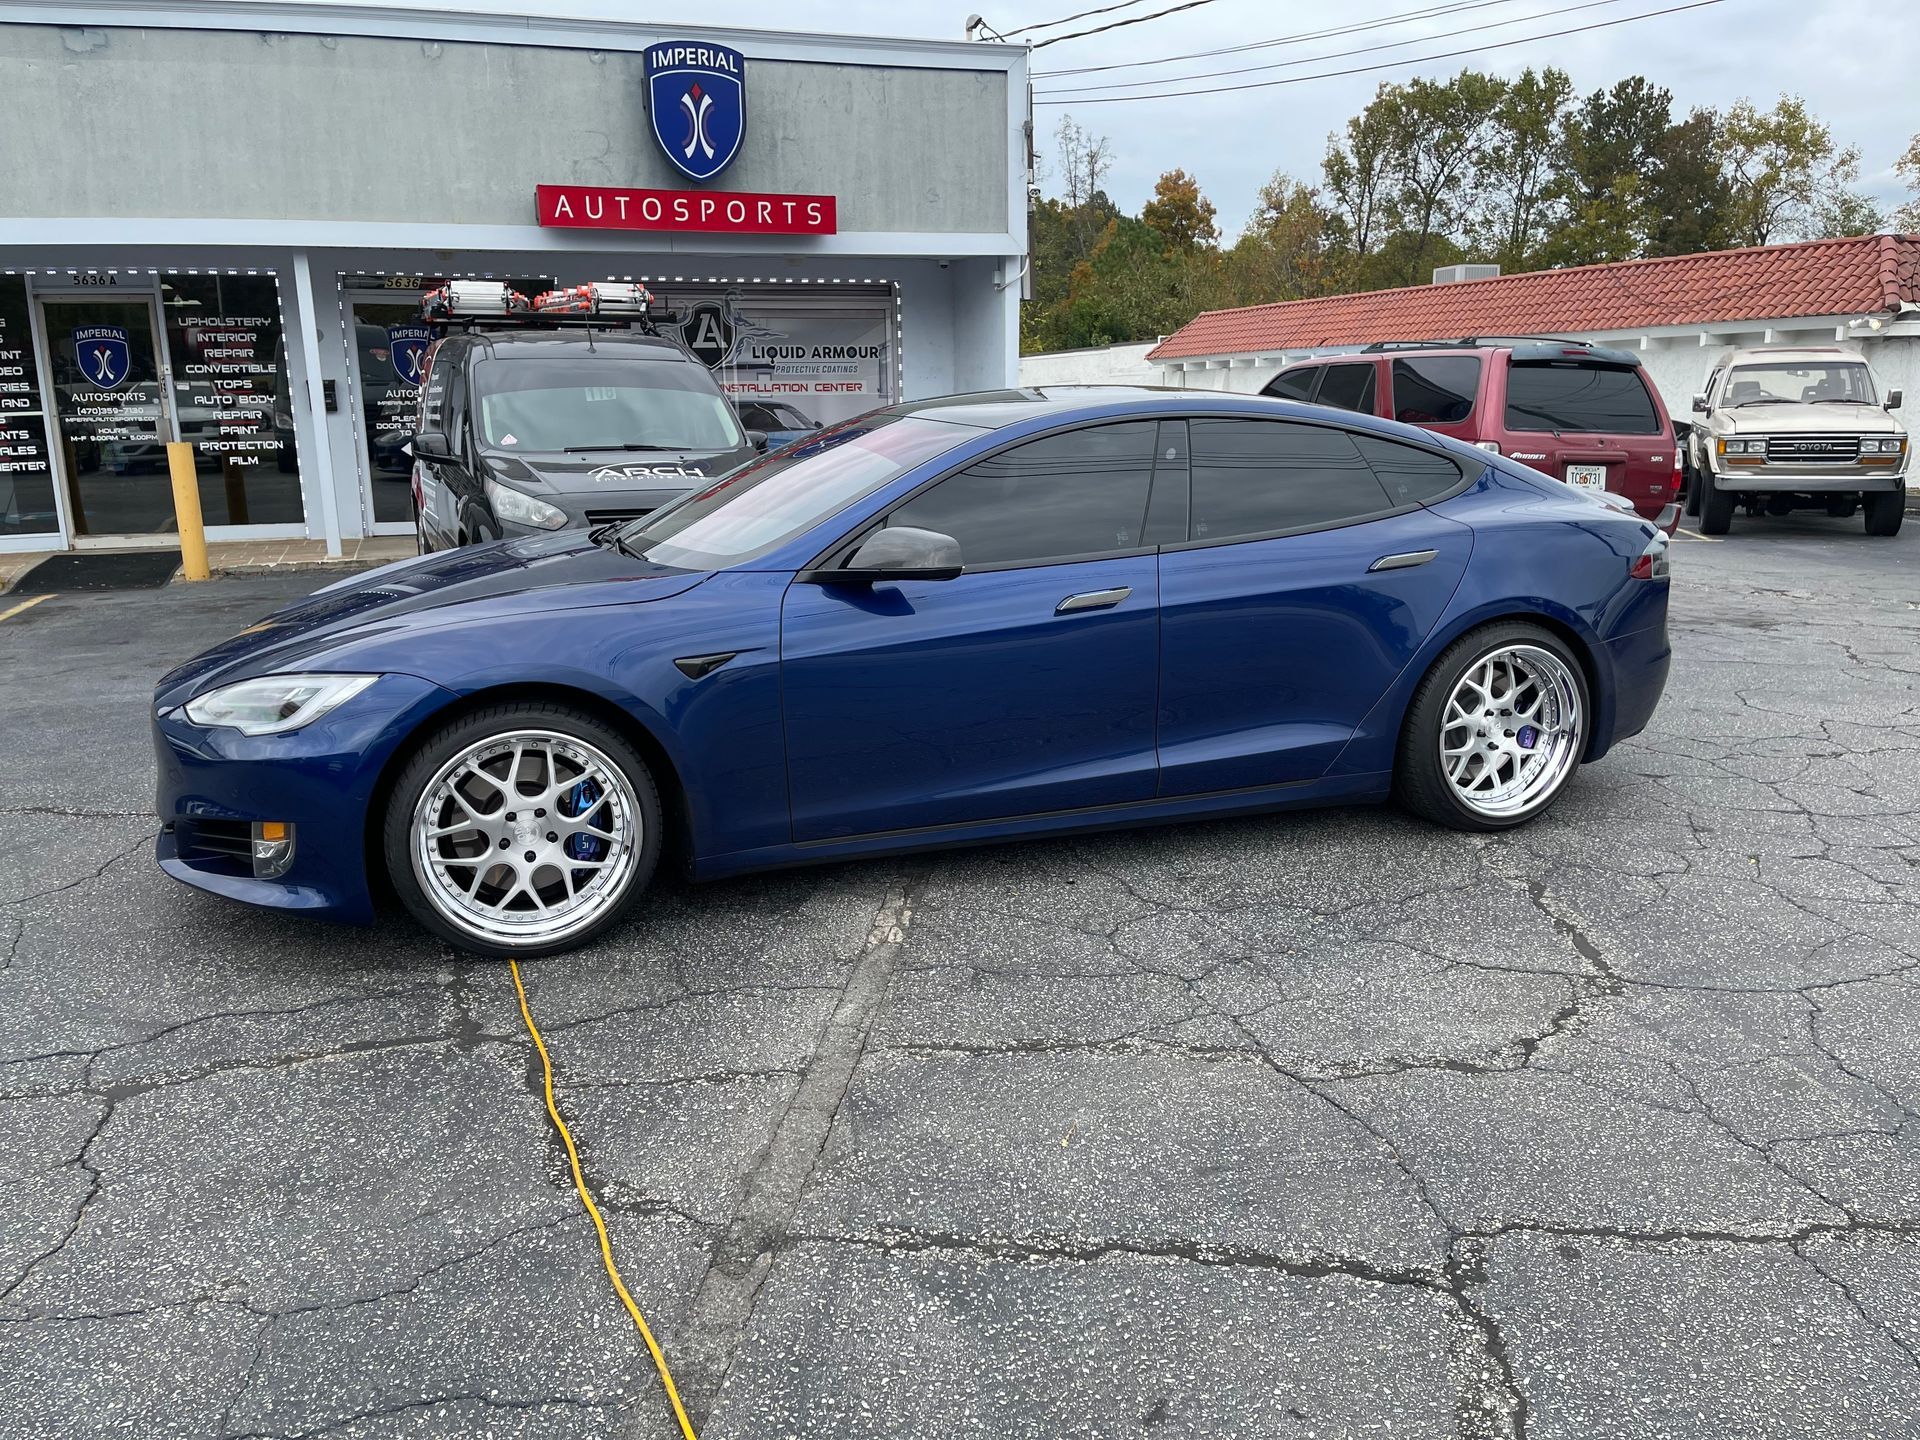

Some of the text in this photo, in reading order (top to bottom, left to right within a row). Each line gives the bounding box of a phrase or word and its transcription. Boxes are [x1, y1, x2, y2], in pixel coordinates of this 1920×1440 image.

[652, 48, 738, 73] IMPERIAL
[554, 194, 822, 225] AUTOSPORTS
[74, 276, 116, 285] 5636 A
[386, 278, 420, 288] 5636
[178, 318, 271, 326] UPHOLSTERY
[76, 328, 126, 340] IMPERIAL
[197, 333, 256, 342] INTERIOR
[204, 349, 254, 358] REPAIR
[752, 346, 878, 362] LIQUID ARMOUR
[185, 364, 277, 373] CONVERTIBLE
[776, 365, 858, 374] PROTECTIVE COATINGS
[214, 380, 253, 388] TOPS
[814, 383, 862, 392] CENTER
[72, 392, 146, 402] AUTOSPORTS
[194, 395, 276, 404] AUTO BODY
[1, 399, 30, 408] AND
[212, 411, 262, 419] REPAIR
[220, 426, 259, 435] PAINT
[200, 440, 284, 451] PROTECTION
[229, 456, 258, 465] FILM
[595, 467, 704, 478] ARCH
